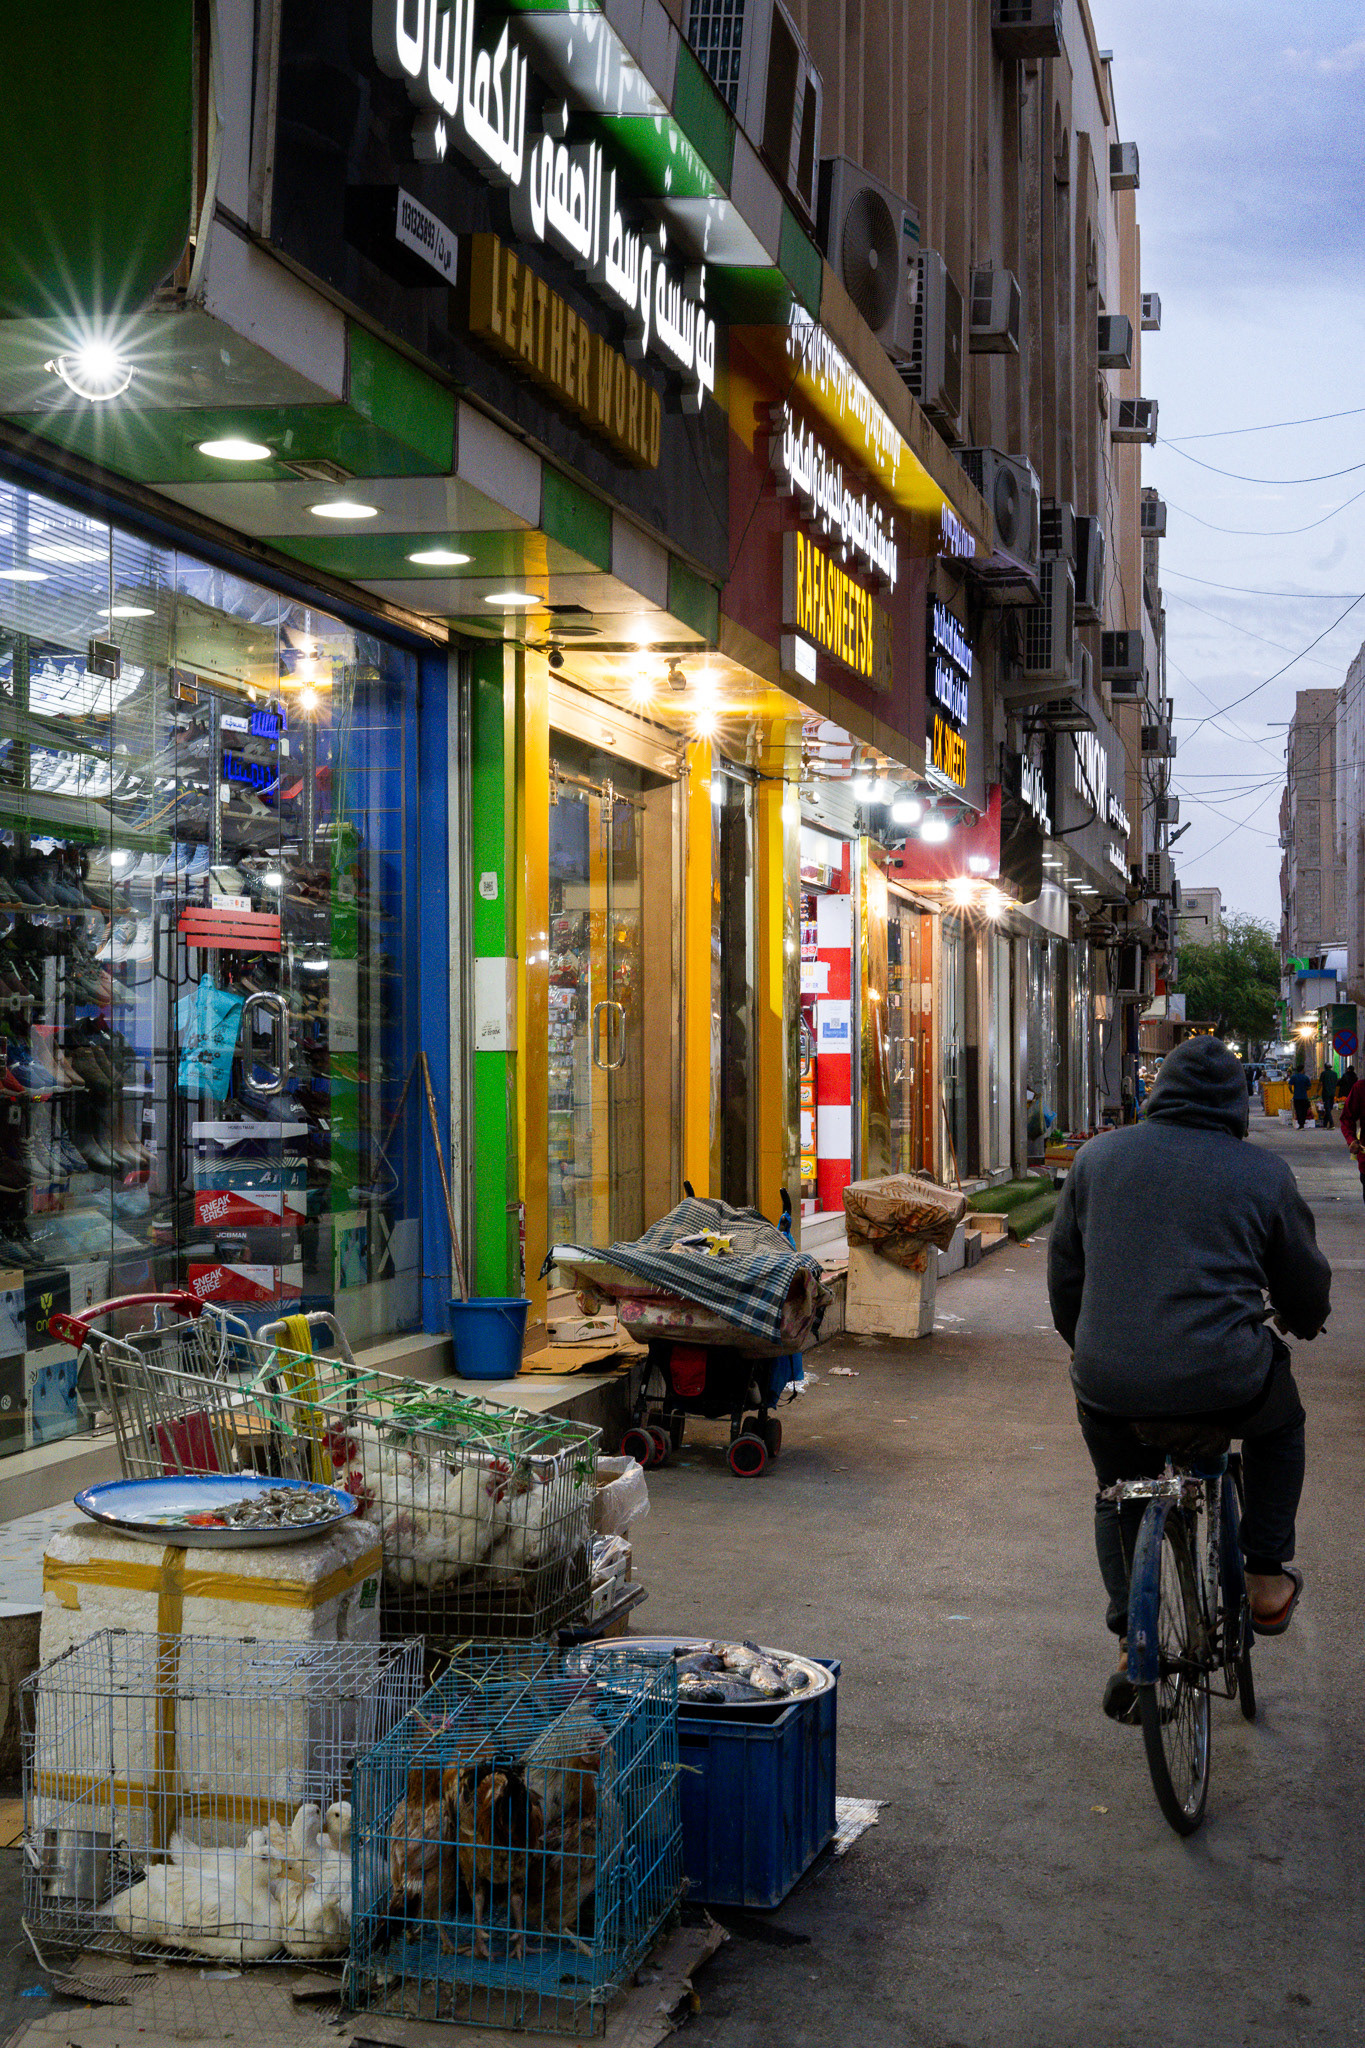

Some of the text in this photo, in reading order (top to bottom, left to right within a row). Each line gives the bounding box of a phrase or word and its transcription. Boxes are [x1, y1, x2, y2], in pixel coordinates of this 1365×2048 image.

[655, 221, 715, 411] مؤسسة
[491, 234, 660, 468] LEATHER WORLD
[945, 724, 967, 788] SWEETS
[199, 1194, 231, 1215] SNEAK
[202, 1205, 229, 1223] ERISE
[192, 1268, 223, 1289] SNEAK
[196, 1279, 221, 1298] ERISE
